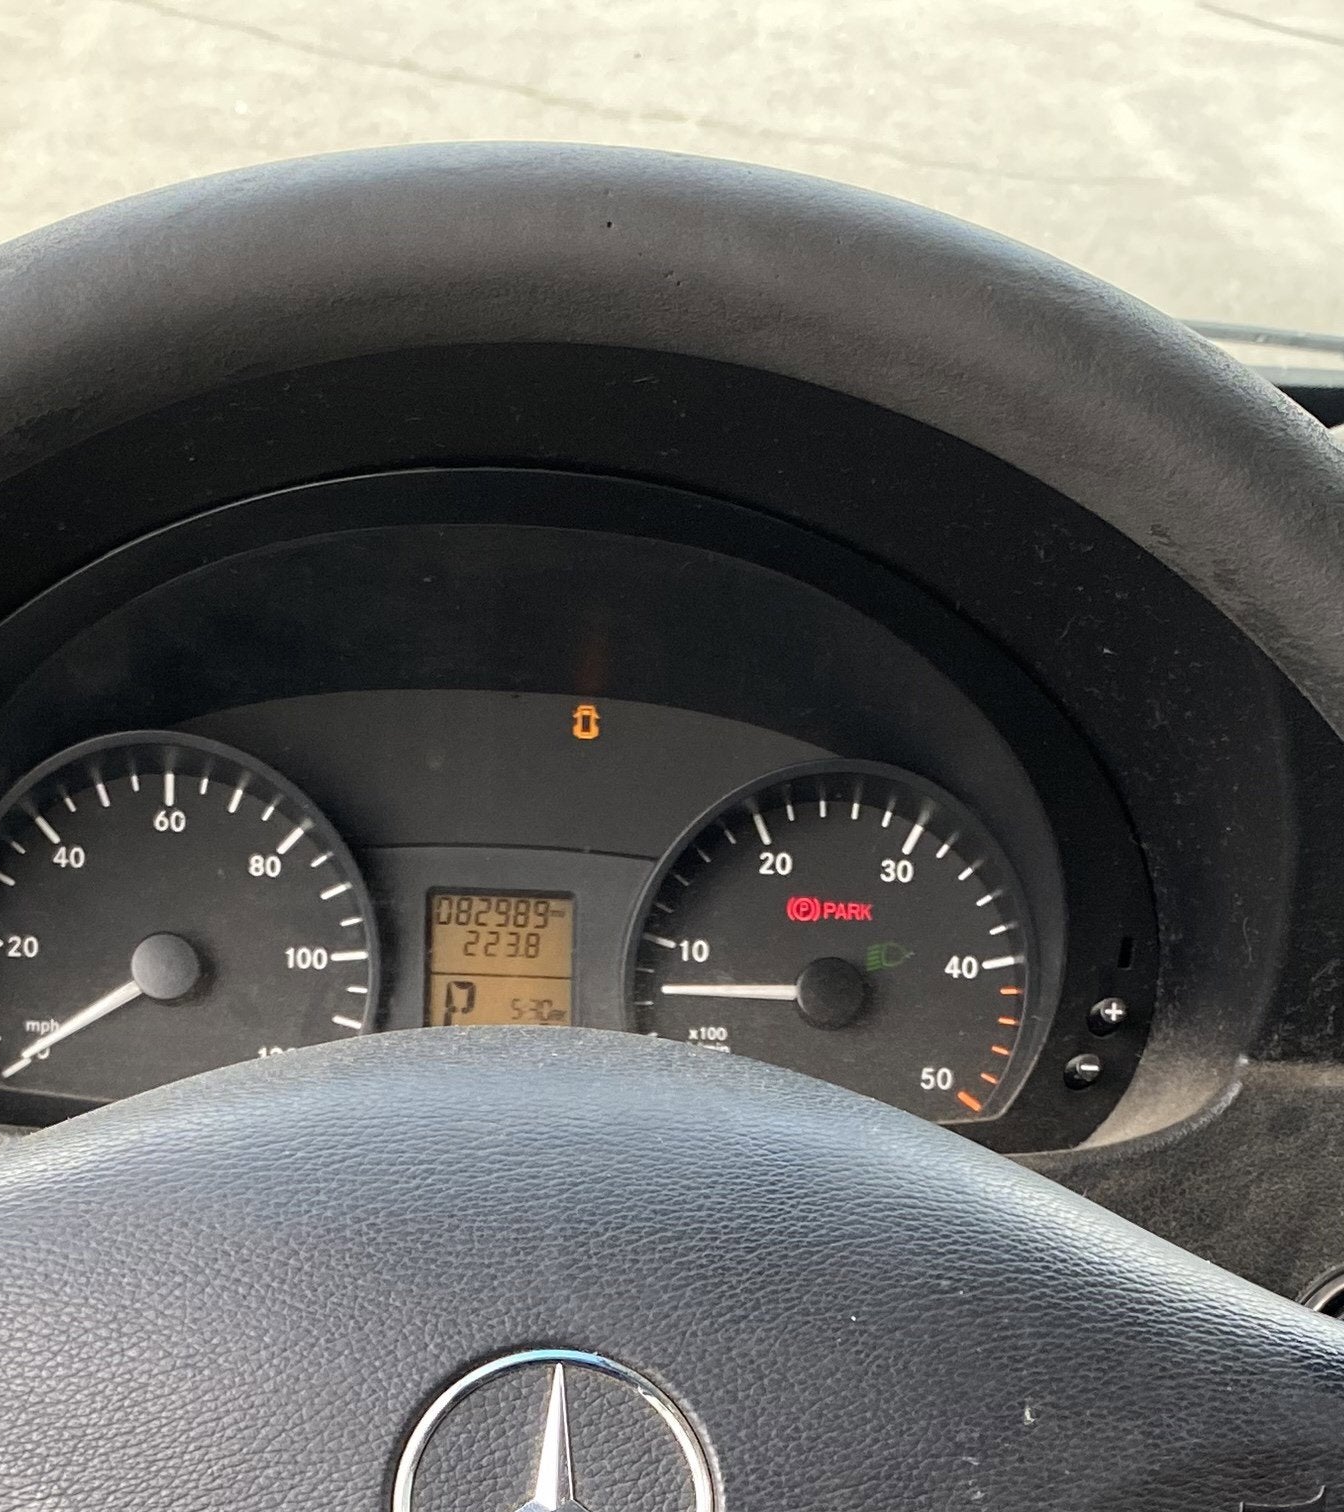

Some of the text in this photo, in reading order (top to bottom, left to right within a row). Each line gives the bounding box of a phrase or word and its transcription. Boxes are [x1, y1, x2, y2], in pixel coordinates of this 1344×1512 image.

[153, 811, 186, 833] 60
[52, 846, 85, 870] 40
[248, 855, 282, 879] 80
[758, 852, 793, 878] 20
[880, 858, 914, 883] 30
[436, 896, 550, 929] 082989
[823, 901, 873, 921] PARK
[6, 936, 39, 959] 20
[286, 947, 328, 970] 100
[678, 939, 710, 963] 10
[945, 955, 979, 980] 40
[25, 1018, 60, 1035] mph
[688, 1026, 729, 1041] x100
[920, 1067, 953, 1092] 50
